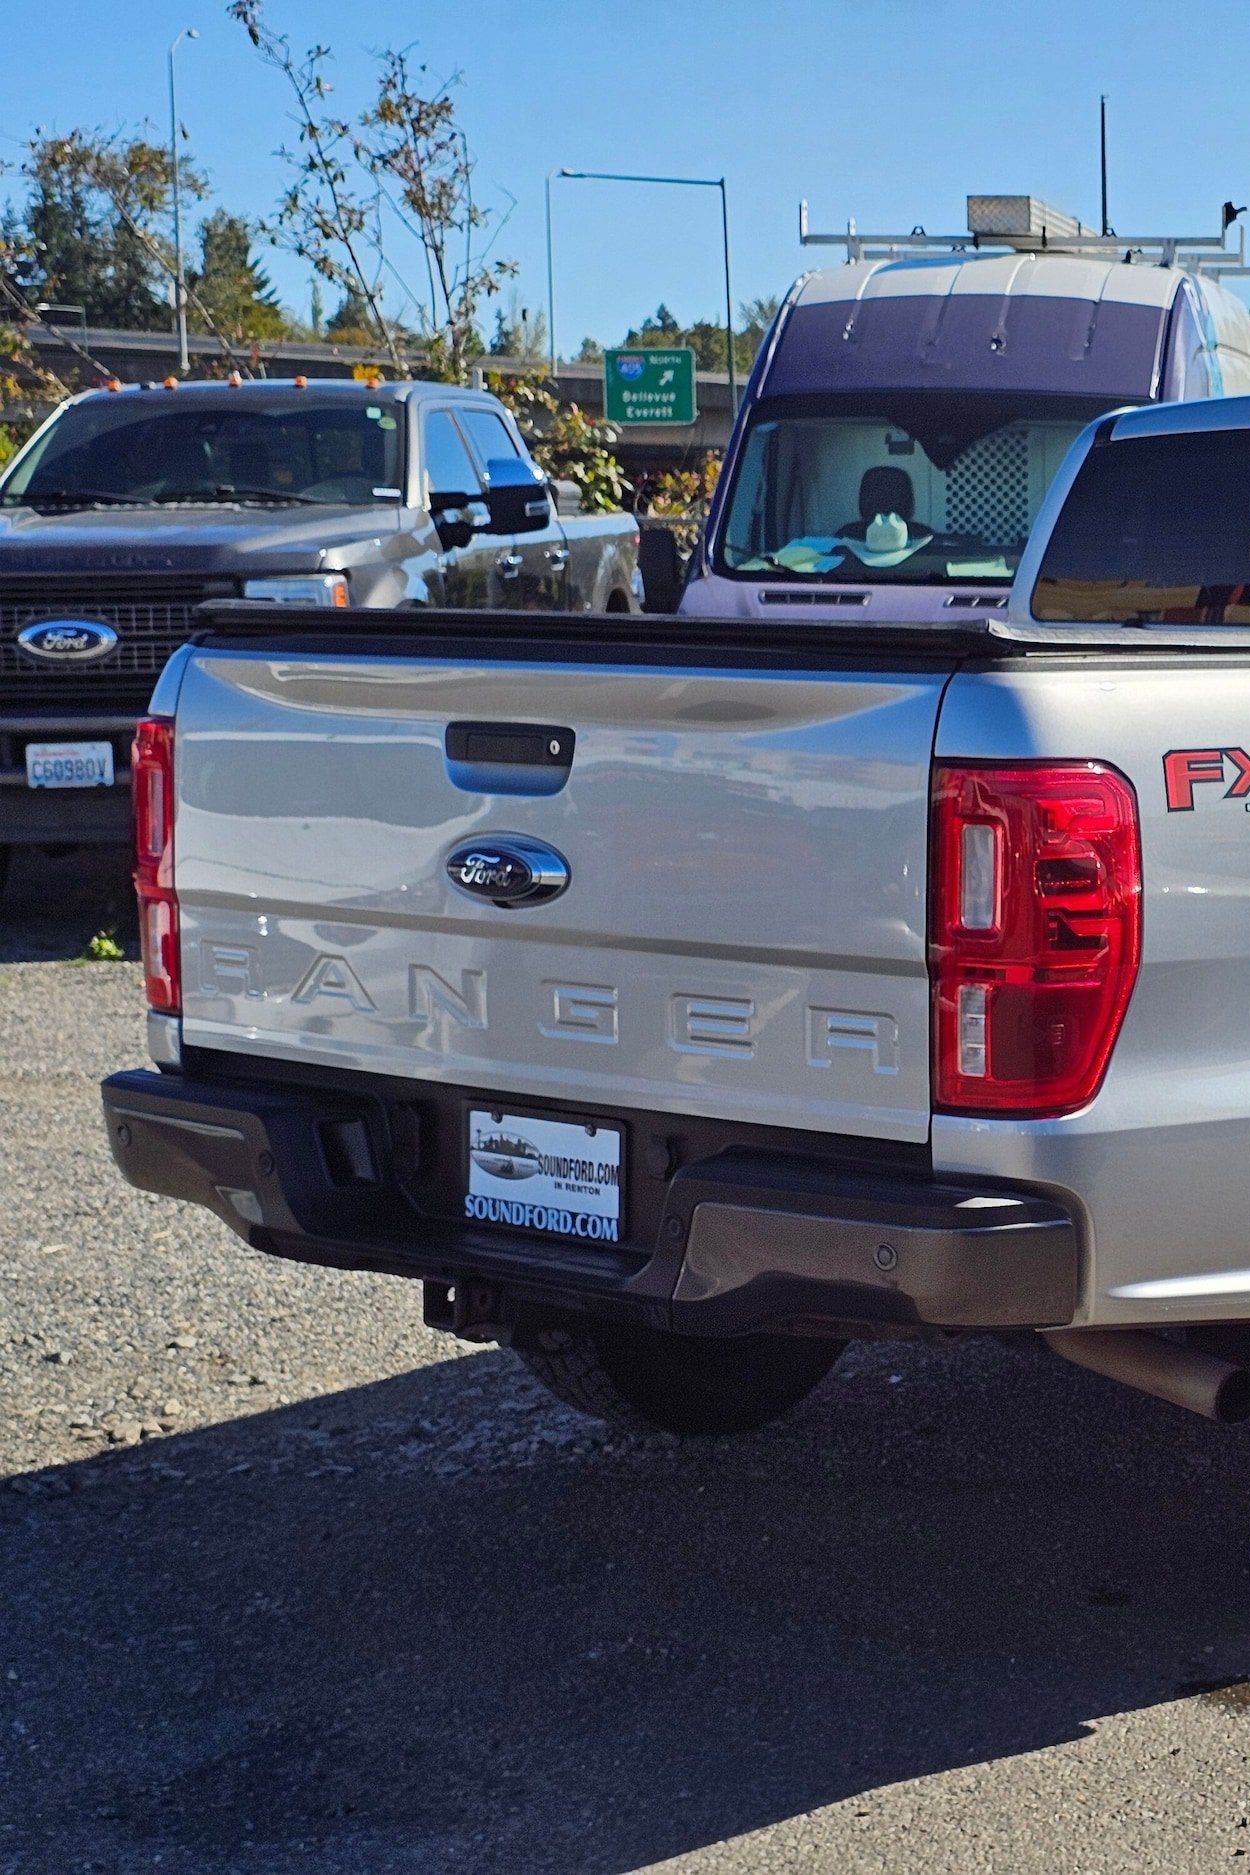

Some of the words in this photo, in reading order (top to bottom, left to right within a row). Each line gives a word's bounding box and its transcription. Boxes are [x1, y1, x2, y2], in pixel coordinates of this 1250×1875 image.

[622, 390, 676, 403] Bellevue
[626, 405, 673, 418] Everett
[43, 630, 88, 650] Ford
[460, 853, 513, 887] Ford
[199, 938, 900, 1076] RANGER
[538, 1153, 620, 1187] SOUNDFORD.COM
[554, 1181, 564, 1190] IN
[566, 1182, 601, 1196] RENTON
[464, 1194, 620, 1243] SOUNDFORD.COM
